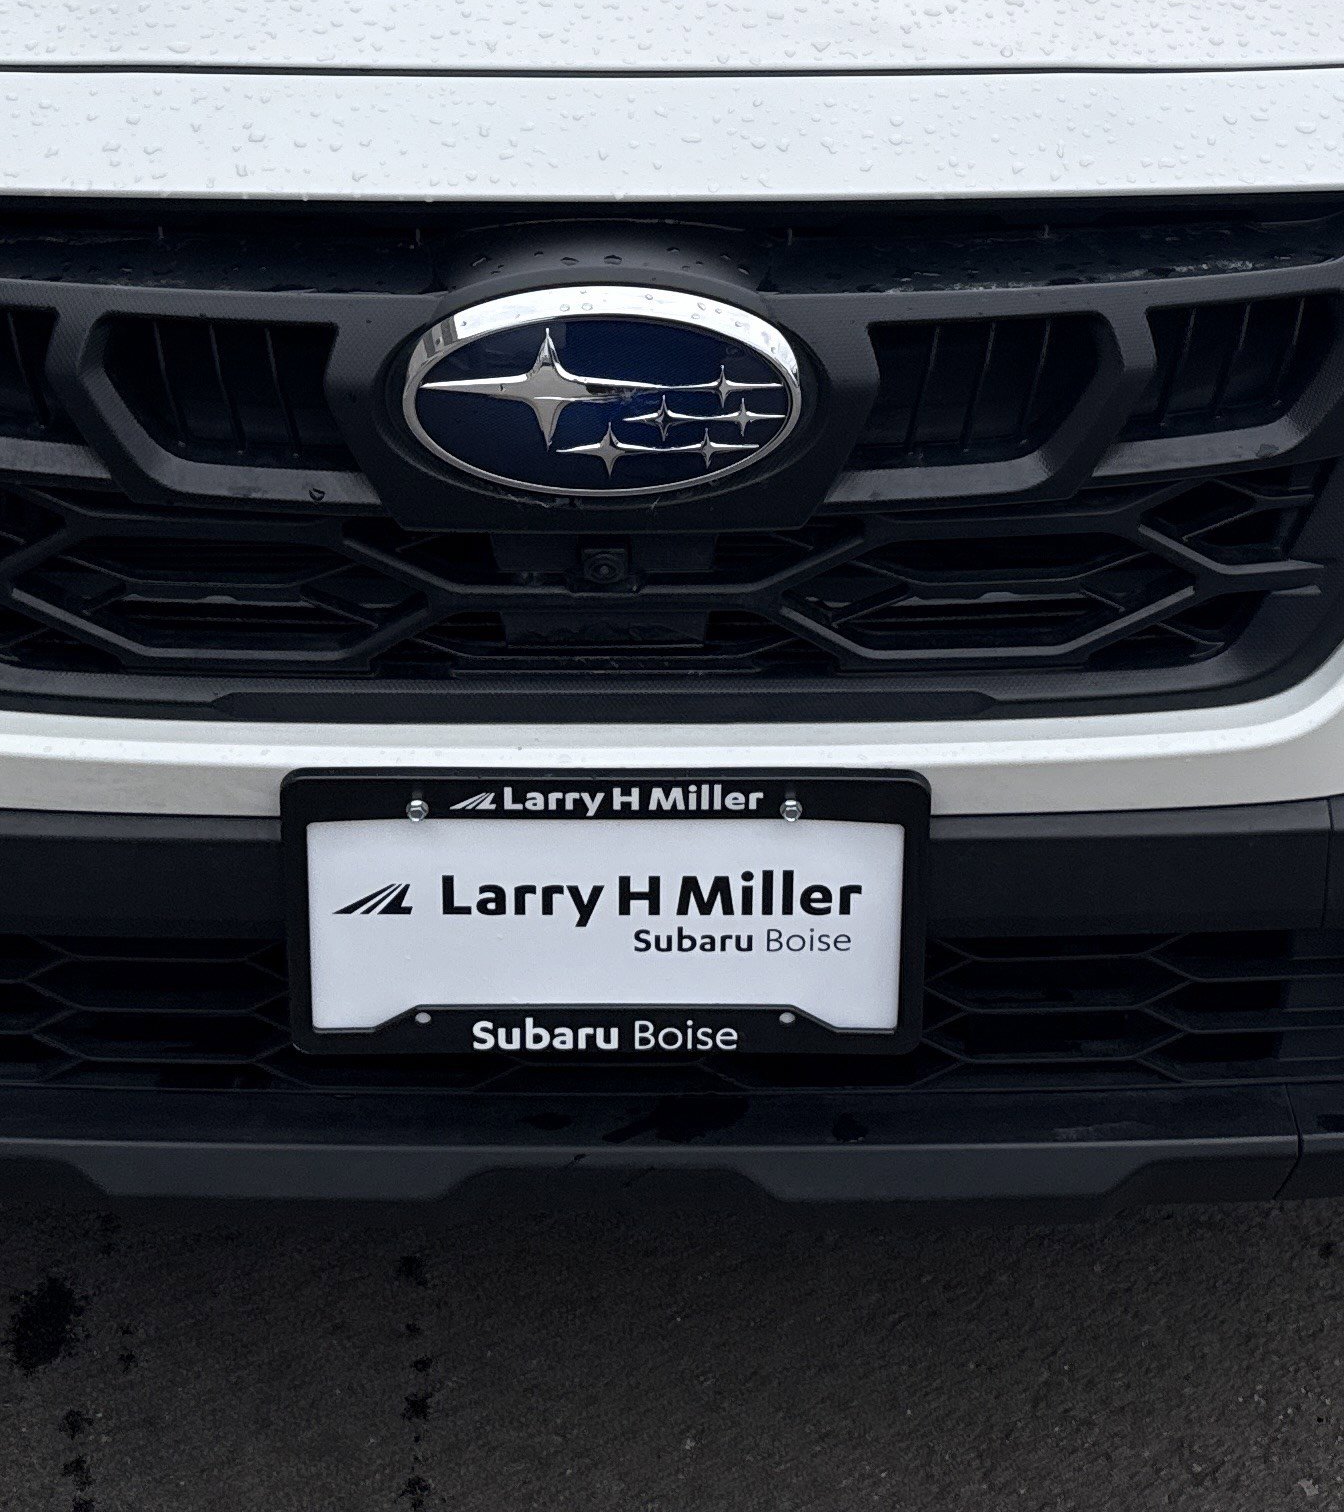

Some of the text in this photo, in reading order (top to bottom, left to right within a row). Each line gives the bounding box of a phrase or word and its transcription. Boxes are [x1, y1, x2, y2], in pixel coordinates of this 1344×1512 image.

[503, 784, 764, 817] Larry H Miller
[441, 870, 863, 927] Larry H Miller
[632, 927, 852, 953] Subaru Boise
[472, 1017, 739, 1051] Subaru Boise
